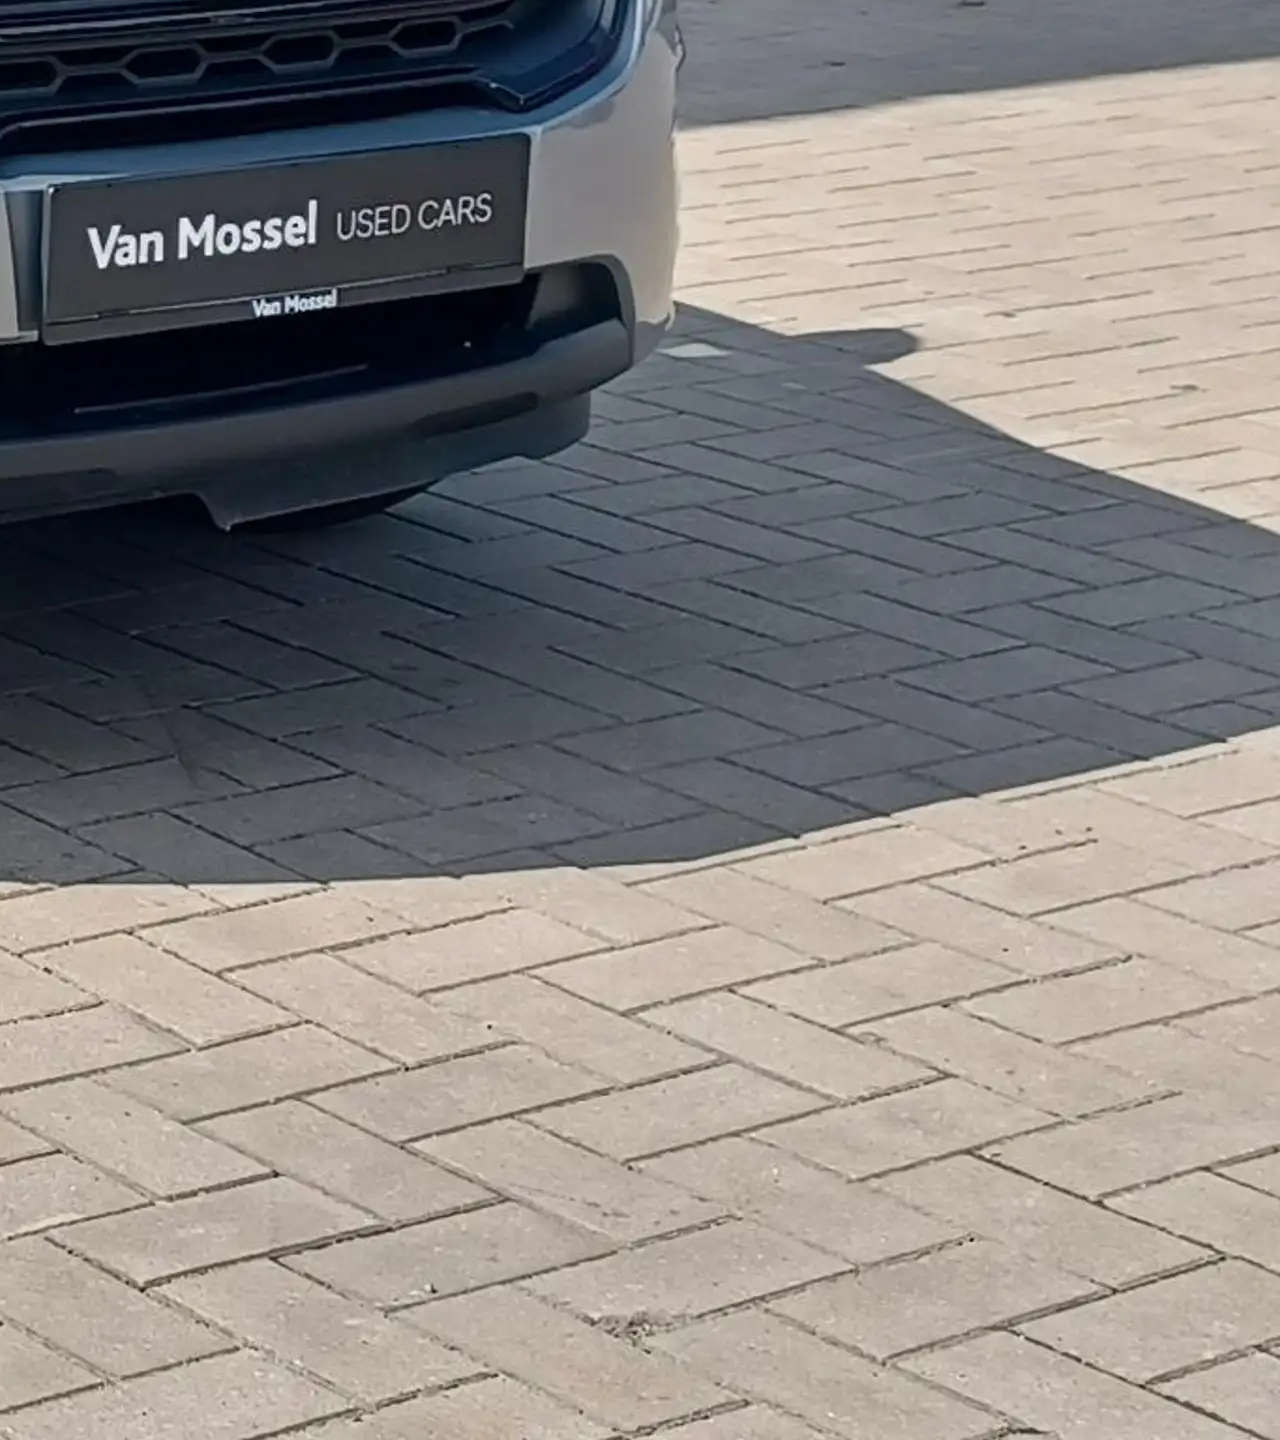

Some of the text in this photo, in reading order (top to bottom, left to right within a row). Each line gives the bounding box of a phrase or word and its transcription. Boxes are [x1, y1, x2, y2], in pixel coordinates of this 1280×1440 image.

[87, 192, 492, 269] Van Mossel USED CARS
[252, 288, 337, 318] Van Mossel
